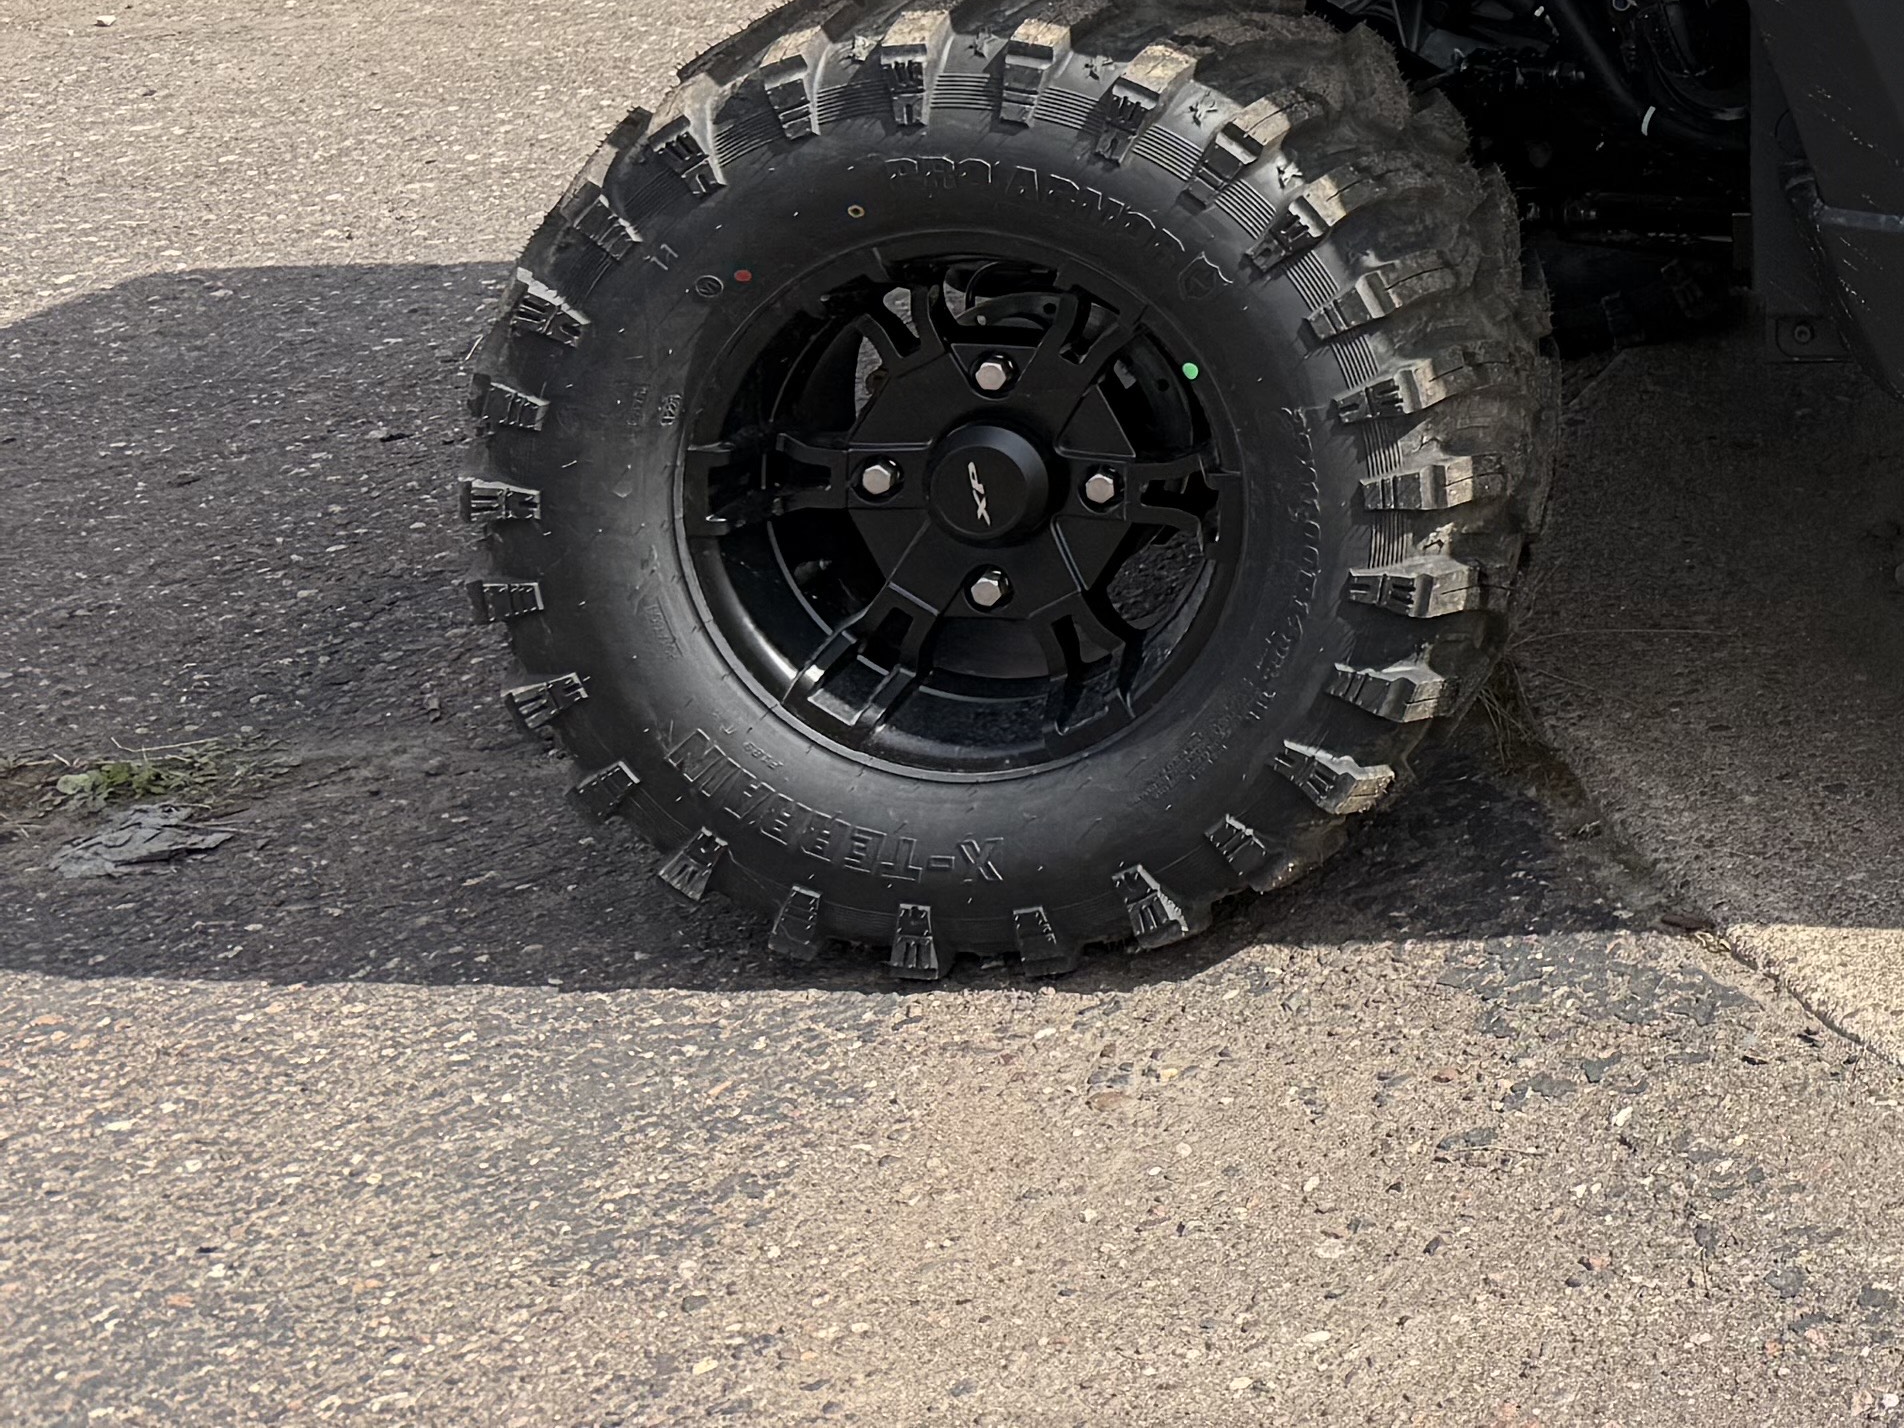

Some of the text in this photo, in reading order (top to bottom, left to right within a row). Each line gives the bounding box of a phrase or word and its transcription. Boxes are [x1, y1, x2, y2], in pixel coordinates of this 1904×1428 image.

[884, 154, 1188, 268] PRO ARMOR
[967, 461, 991, 527] XP
[664, 727, 1004, 884] X-TERRAIN
